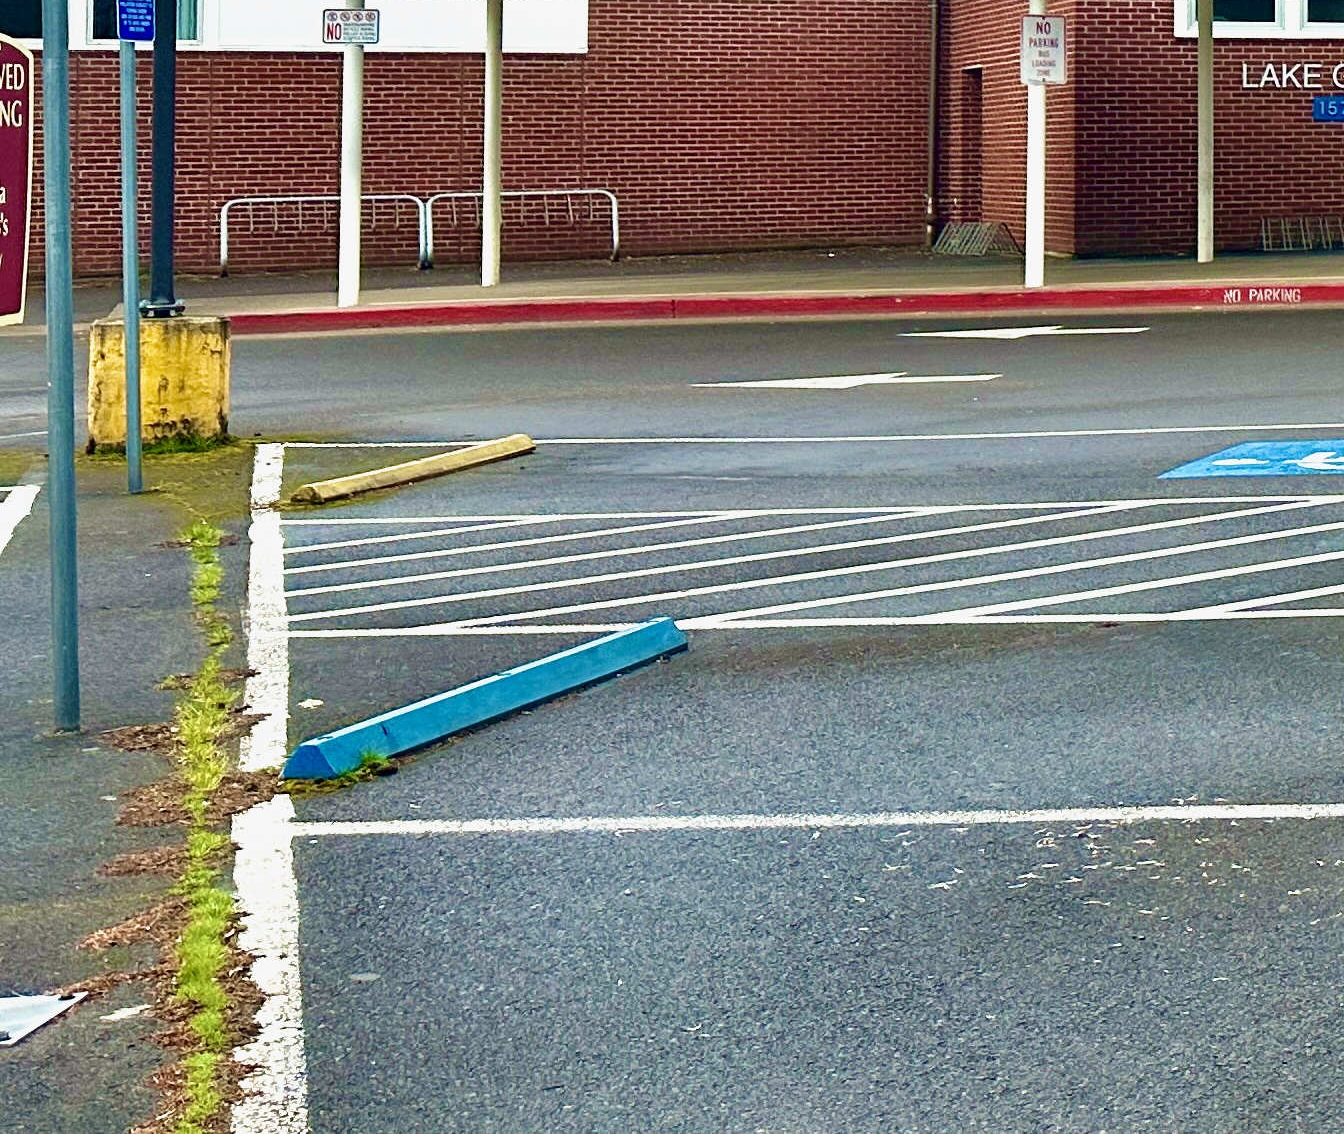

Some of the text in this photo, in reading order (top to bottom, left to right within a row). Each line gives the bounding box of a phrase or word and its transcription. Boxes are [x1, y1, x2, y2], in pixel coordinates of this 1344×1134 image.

[326, 22, 342, 40] NO
[1035, 22, 1051, 34] NO
[1028, 37, 1059, 48] PARKING
[1241, 63, 1323, 89] LAKE
[1223, 288, 1301, 304] NO PARKING
